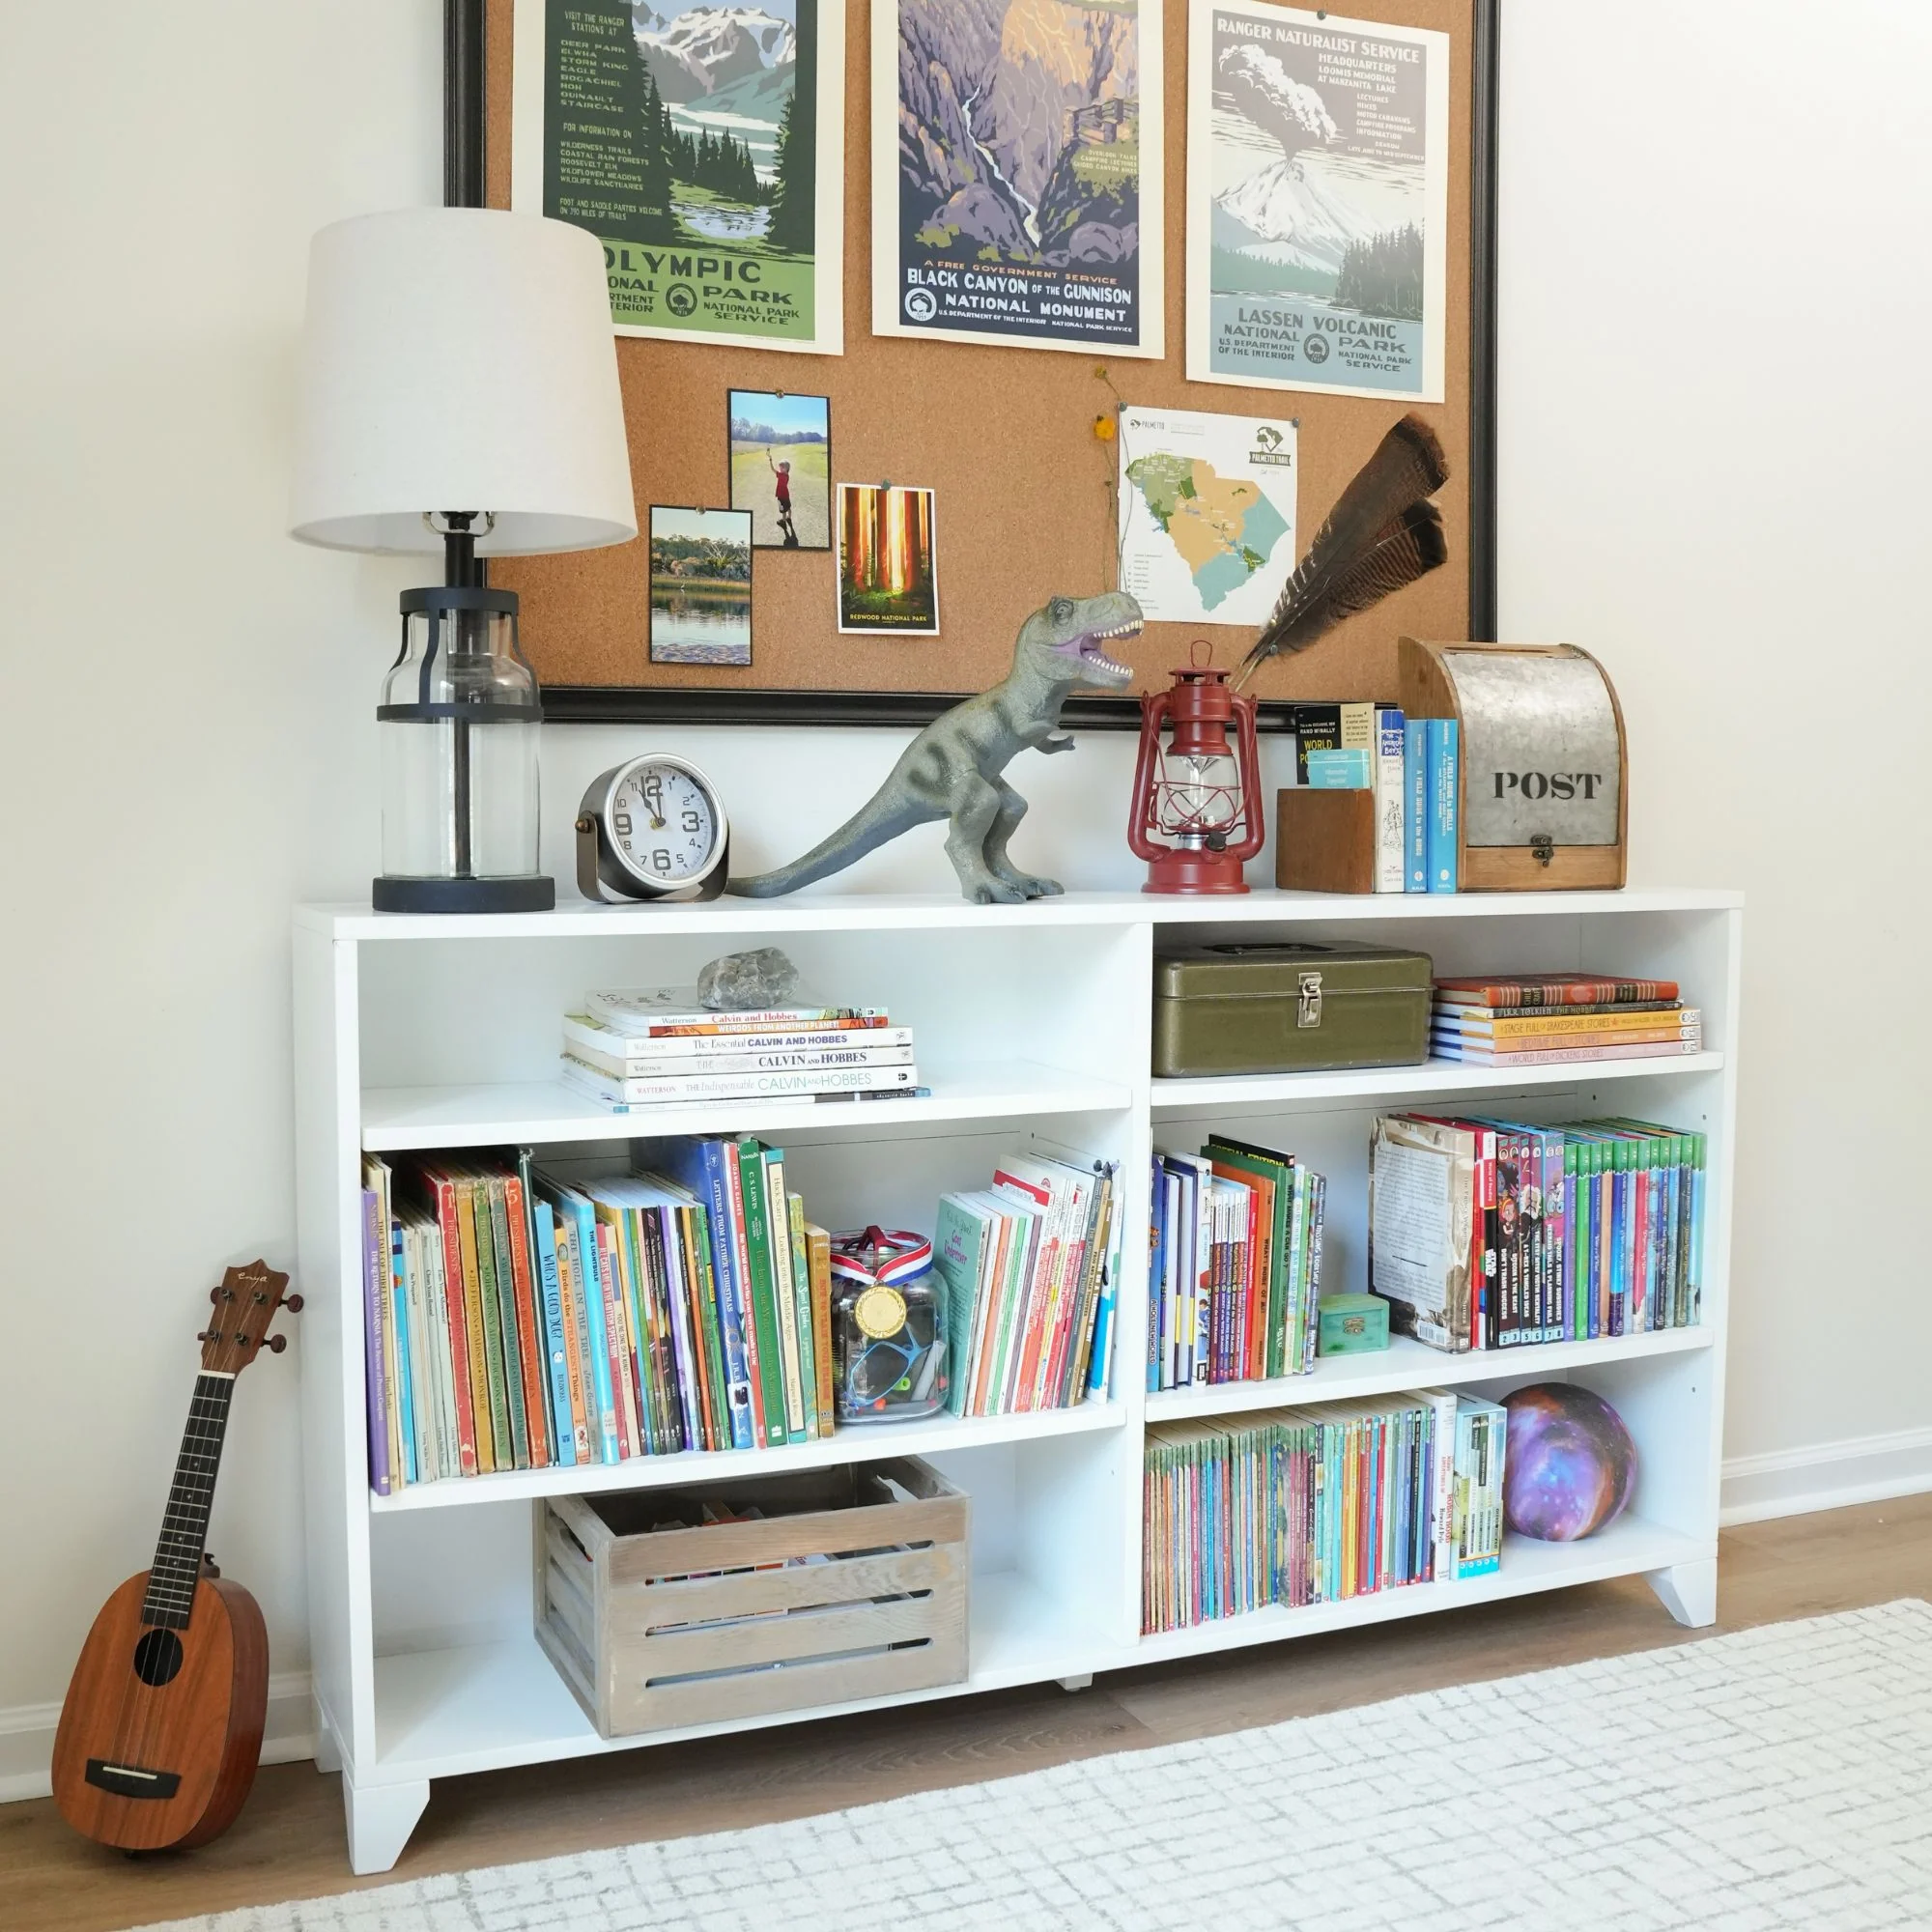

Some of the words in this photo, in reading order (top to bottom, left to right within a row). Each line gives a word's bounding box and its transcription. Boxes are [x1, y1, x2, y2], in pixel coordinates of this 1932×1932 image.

[564, 11, 581, 20] VISIT
[584, 14, 596, 23] THE
[599, 14, 625, 27] RANGER
[572, 22, 605, 35] STATIONS
[609, 27, 616, 36] AT
[560, 40, 589, 48] DEER
[594, 43, 627, 53] PARK
[1217, 17, 1271, 41] RANGER
[1275, 29, 1357, 54] NATURALIST
[1360, 42, 1420, 64] SERVICE
[560, 48, 597, 58] ELWHA
[560, 57, 597, 67] STORM
[603, 62, 629, 71] KING
[560, 66, 596, 75] EAGLE
[1319, 53, 1397, 73] HEADQUARTERS
[560, 74, 622, 88] BOGACHIEL
[1319, 65, 1351, 77] LOOMIS
[1352, 71, 1396, 84] MEMORIAL
[1328, 76, 1372, 90] MANZANITA
[1376, 83, 1397, 93] LAKE
[560, 99, 624, 113] STAIRCASE
[1356, 93, 1389, 103] LECTURES
[563, 123, 576, 132] FOR
[579, 125, 620, 137] INFORMATION
[623, 130, 632, 139] ON
[1356, 128, 1403, 140] INFORMATION
[937, 261, 965, 270] FREE
[973, 264, 1058, 279] GOVERNMENT
[1065, 273, 1117, 285] SERVICE
[907, 268, 958, 289] BLACK
[964, 272, 1028, 295] CANYON
[1032, 284, 1042, 294] OF
[1046, 286, 1060, 296] THE
[1064, 283, 1131, 305] GUNNISON
[703, 285, 793, 305] PARK
[703, 301, 761, 315] NATIONAL
[766, 307, 800, 319] PARK
[945, 293, 1030, 314] NATIONAL
[1040, 301, 1126, 323] MONUMENT
[714, 311, 788, 326] SERVICE
[1238, 307, 1303, 328] LASSEN
[1313, 315, 1397, 339] VOLCANIC
[1224, 324, 1300, 342] NATIONAL
[1338, 337, 1406, 354] PARK
[1233, 347, 1249, 356] THE
[1252, 349, 1295, 361] INTERIOR
[1338, 351, 1382, 362] NATIONAL
[1386, 355, 1412, 365] PARK
[1346, 358, 1401, 372] SERVICE
[1142, 420, 1165, 430] PALMETTO
[1251, 453, 1275, 463] PALMETTO
[1303, 739, 1333, 750] WORLD
[631, 781, 638, 792] 11
[640, 775, 664, 797] 12
[668, 781, 672, 791] 1
[1492, 772, 1602, 800] POST
[617, 798, 627, 808] 10
[682, 796, 690, 806] 2
[615, 813, 633, 836] 9
[681, 811, 700, 832] 3
[624, 840, 632, 850] 8
[689, 838, 696, 847] 4
[639, 855, 647, 865] 7
[652, 849, 671, 870] 6
[676, 854, 684, 863] 5
[711, 1013, 743, 1024] Calvin
[745, 1012, 761, 1022] and
[764, 1011, 797, 1021] Hobbes
[1570, 1006, 1596, 1014] HOBBIT
[717, 1023, 753, 1033] WEIRDOS
[755, 1023, 773, 1032] FROM
[775, 1021, 808, 1030] ANOTHER
[810, 1020, 839, 1029] PLANET!
[694, 1039, 709, 1049] The
[711, 1038, 746, 1048] Essential
[748, 1037, 782, 1046] CALVIN
[785, 1037, 806, 1045] AND
[808, 1035, 847, 1044] HOBBES
[758, 1055, 806, 1067] CALVIN
[821, 1052, 867, 1064] HOBBES
[701, 1079, 753, 1093] Indispensable
[758, 1077, 807, 1091] CALVIN
[821, 1073, 871, 1087] HOBBES
[508, 1189, 518, 1205] 5
[714, 1179, 723, 1212] LETTERS
[569, 1232, 578, 1253] THE
[720, 1238, 728, 1267] FATHER
[543, 1254, 556, 1282] WHO'S
[590, 1244, 599, 1282] LIGHTBULB
[572, 1257, 582, 1287] HOLE
[723, 1268, 733, 1312] CHRISTMAS
[469, 1274, 479, 1325] JEFFERSON
[547, 1293, 559, 1316] GOOD
[575, 1293, 584, 1304] IN
[1084, 1292, 1093, 1317] TOGETHER
[578, 1309, 586, 1330] THE
[549, 1317, 562, 1339] DOG?
[562, 1290, 568, 1303] do
[566, 1319, 578, 1373] STRANGEST
[474, 1329, 483, 1369] MADISON
[580, 1336, 588, 1360] TREE
[478, 1373, 487, 1409] MONROE
